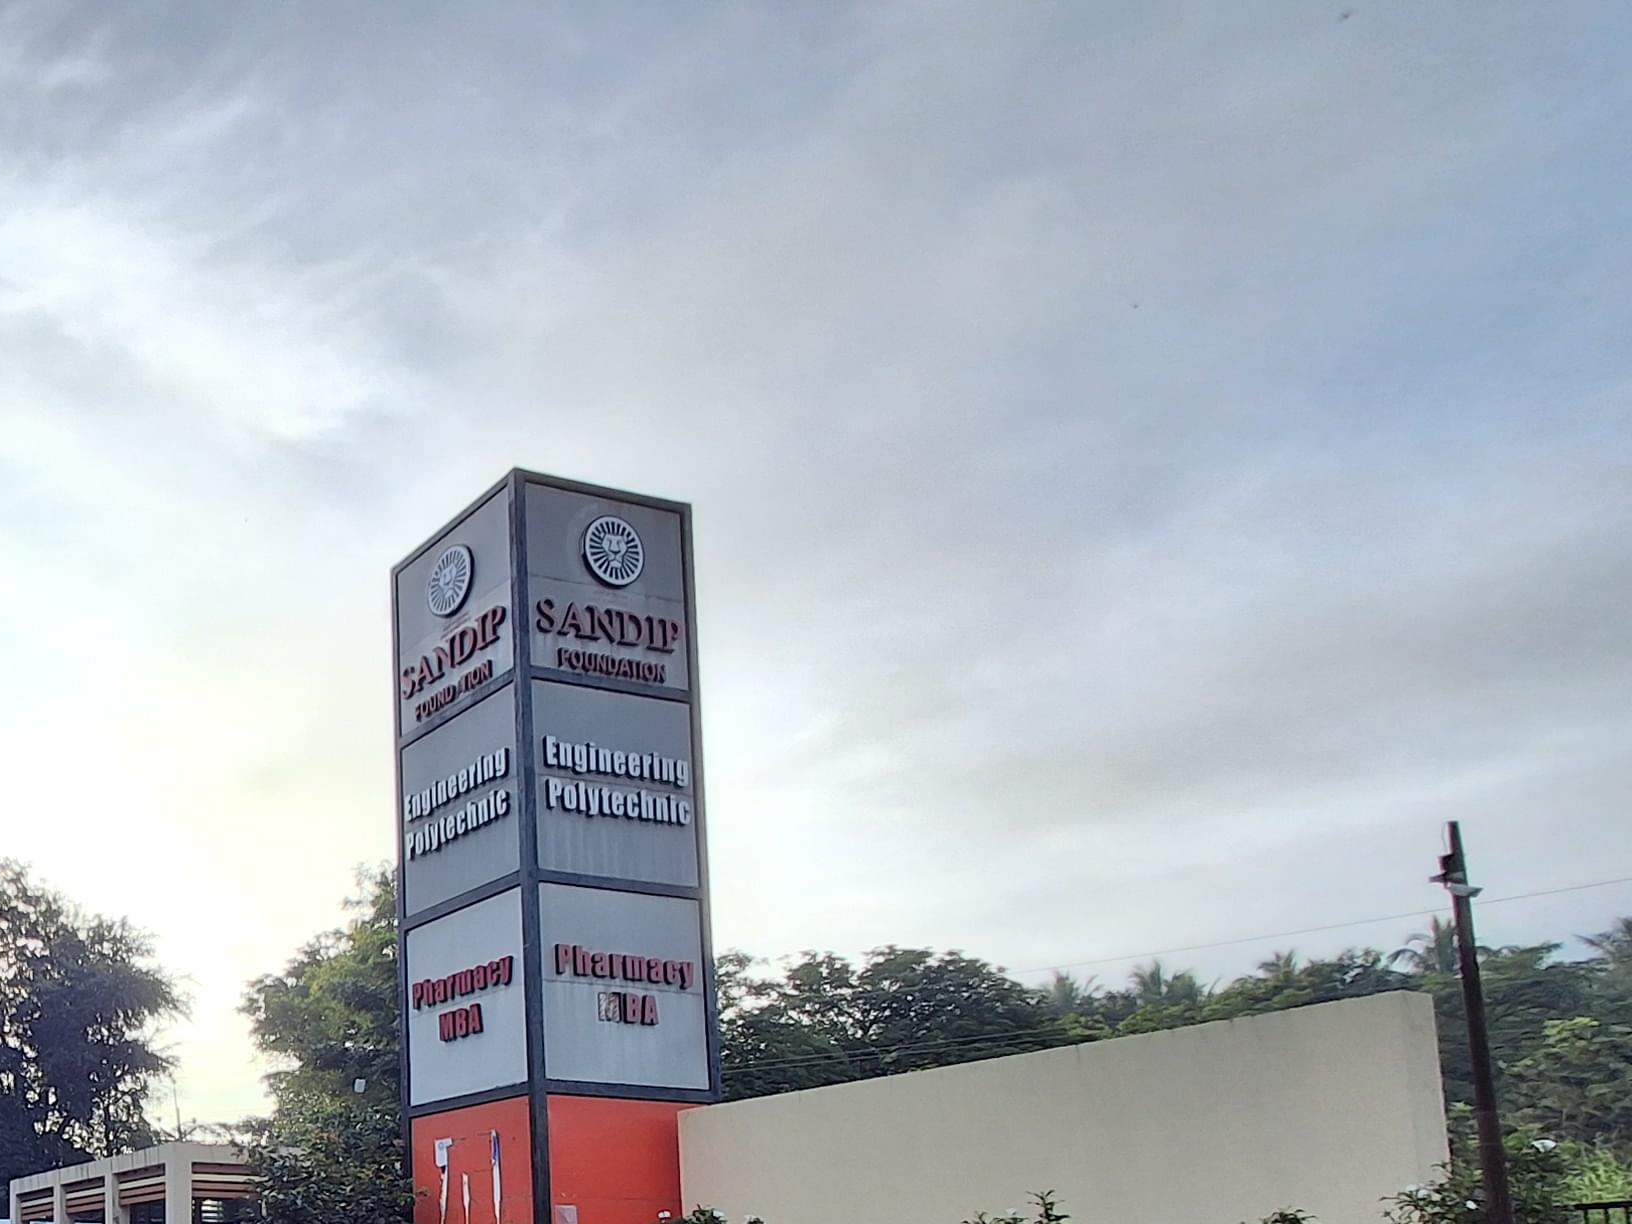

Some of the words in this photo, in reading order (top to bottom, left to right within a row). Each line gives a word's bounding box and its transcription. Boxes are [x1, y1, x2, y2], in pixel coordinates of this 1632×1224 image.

[536, 599, 681, 653] SANDIP
[401, 606, 506, 699] SANDIP
[558, 648, 666, 683] FOUNDATION
[404, 748, 509, 822] Engineering
[543, 736, 689, 788] Engineering
[405, 788, 510, 861] Polytechnic
[546, 778, 691, 826] Polytechnic
[412, 955, 514, 1010] Pharmacy
[555, 944, 694, 989] Pharmacy
[439, 1003, 484, 1042] MBA
[598, 992, 659, 1025] MBA
